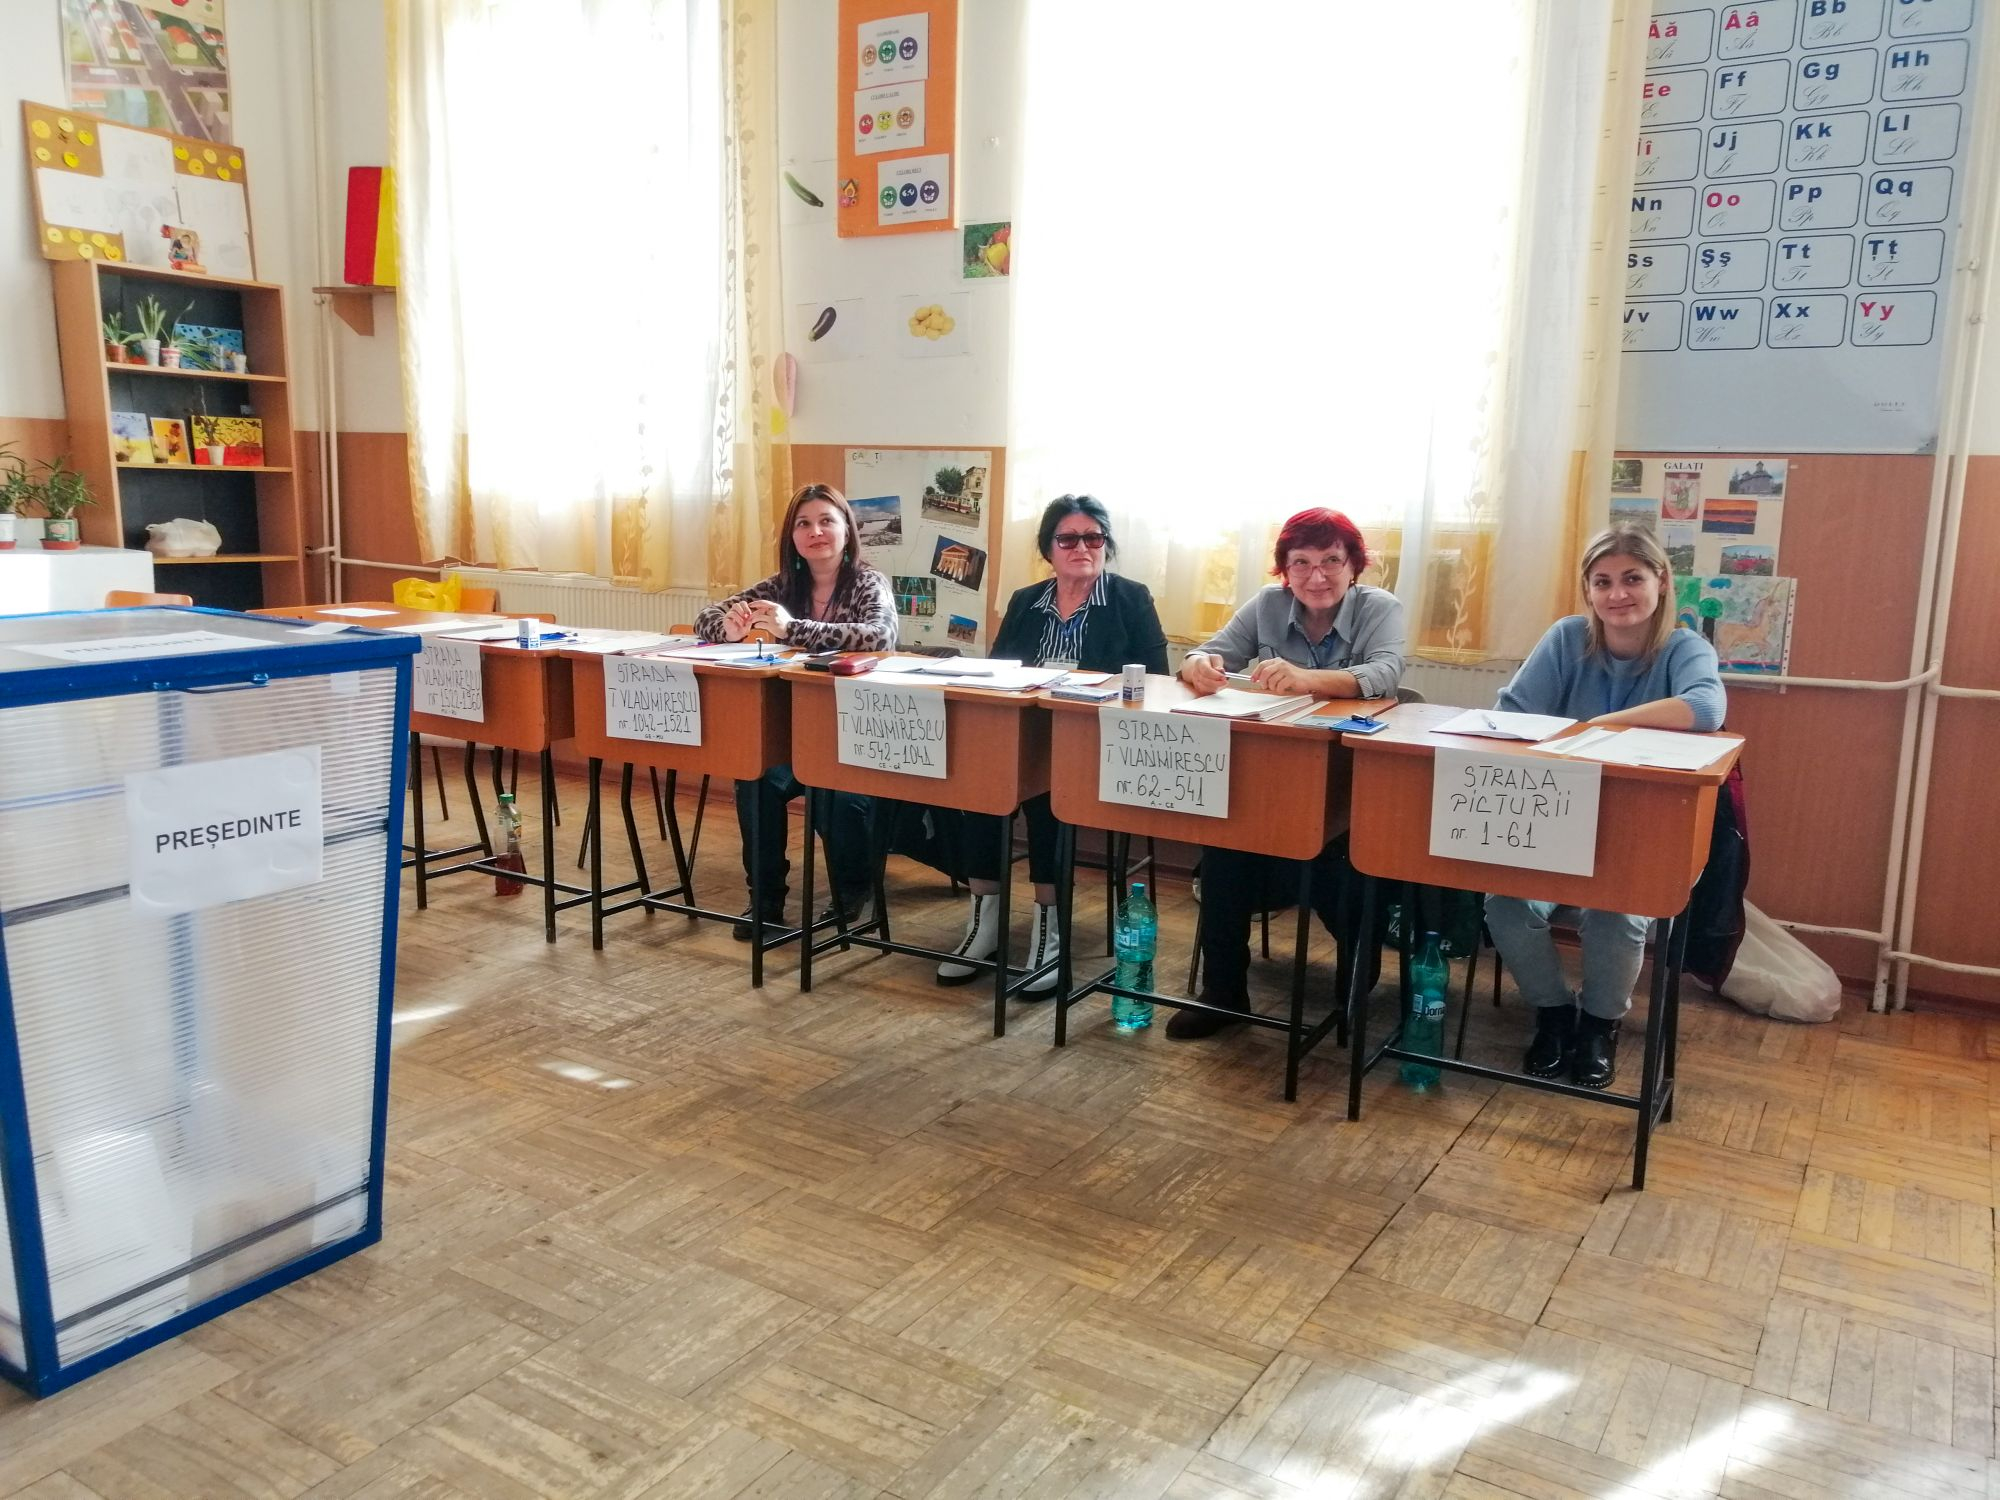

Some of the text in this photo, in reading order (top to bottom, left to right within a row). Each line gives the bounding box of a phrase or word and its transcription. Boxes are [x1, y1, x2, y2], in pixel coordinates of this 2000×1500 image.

[1720, 71, 1747, 89] Ff
[1803, 62, 1840, 81] Gg
[1891, 50, 1930, 69] Hh
[1713, 131, 1738, 151] Jj
[1795, 122, 1833, 141] Kk
[1706, 192, 1741, 208] Oo
[1788, 184, 1822, 203] Pp
[1875, 178, 1914, 197] Qq
[1695, 306, 1740, 322] Ww
[1774, 302, 1811, 319] Xx
[1860, 301, 1895, 321] Yy
[618, 663, 677, 682] STRADA
[854, 688, 919, 716] STRADA
[1118, 719, 1194, 744] STRADA
[1464, 765, 1558, 791] STRADA
